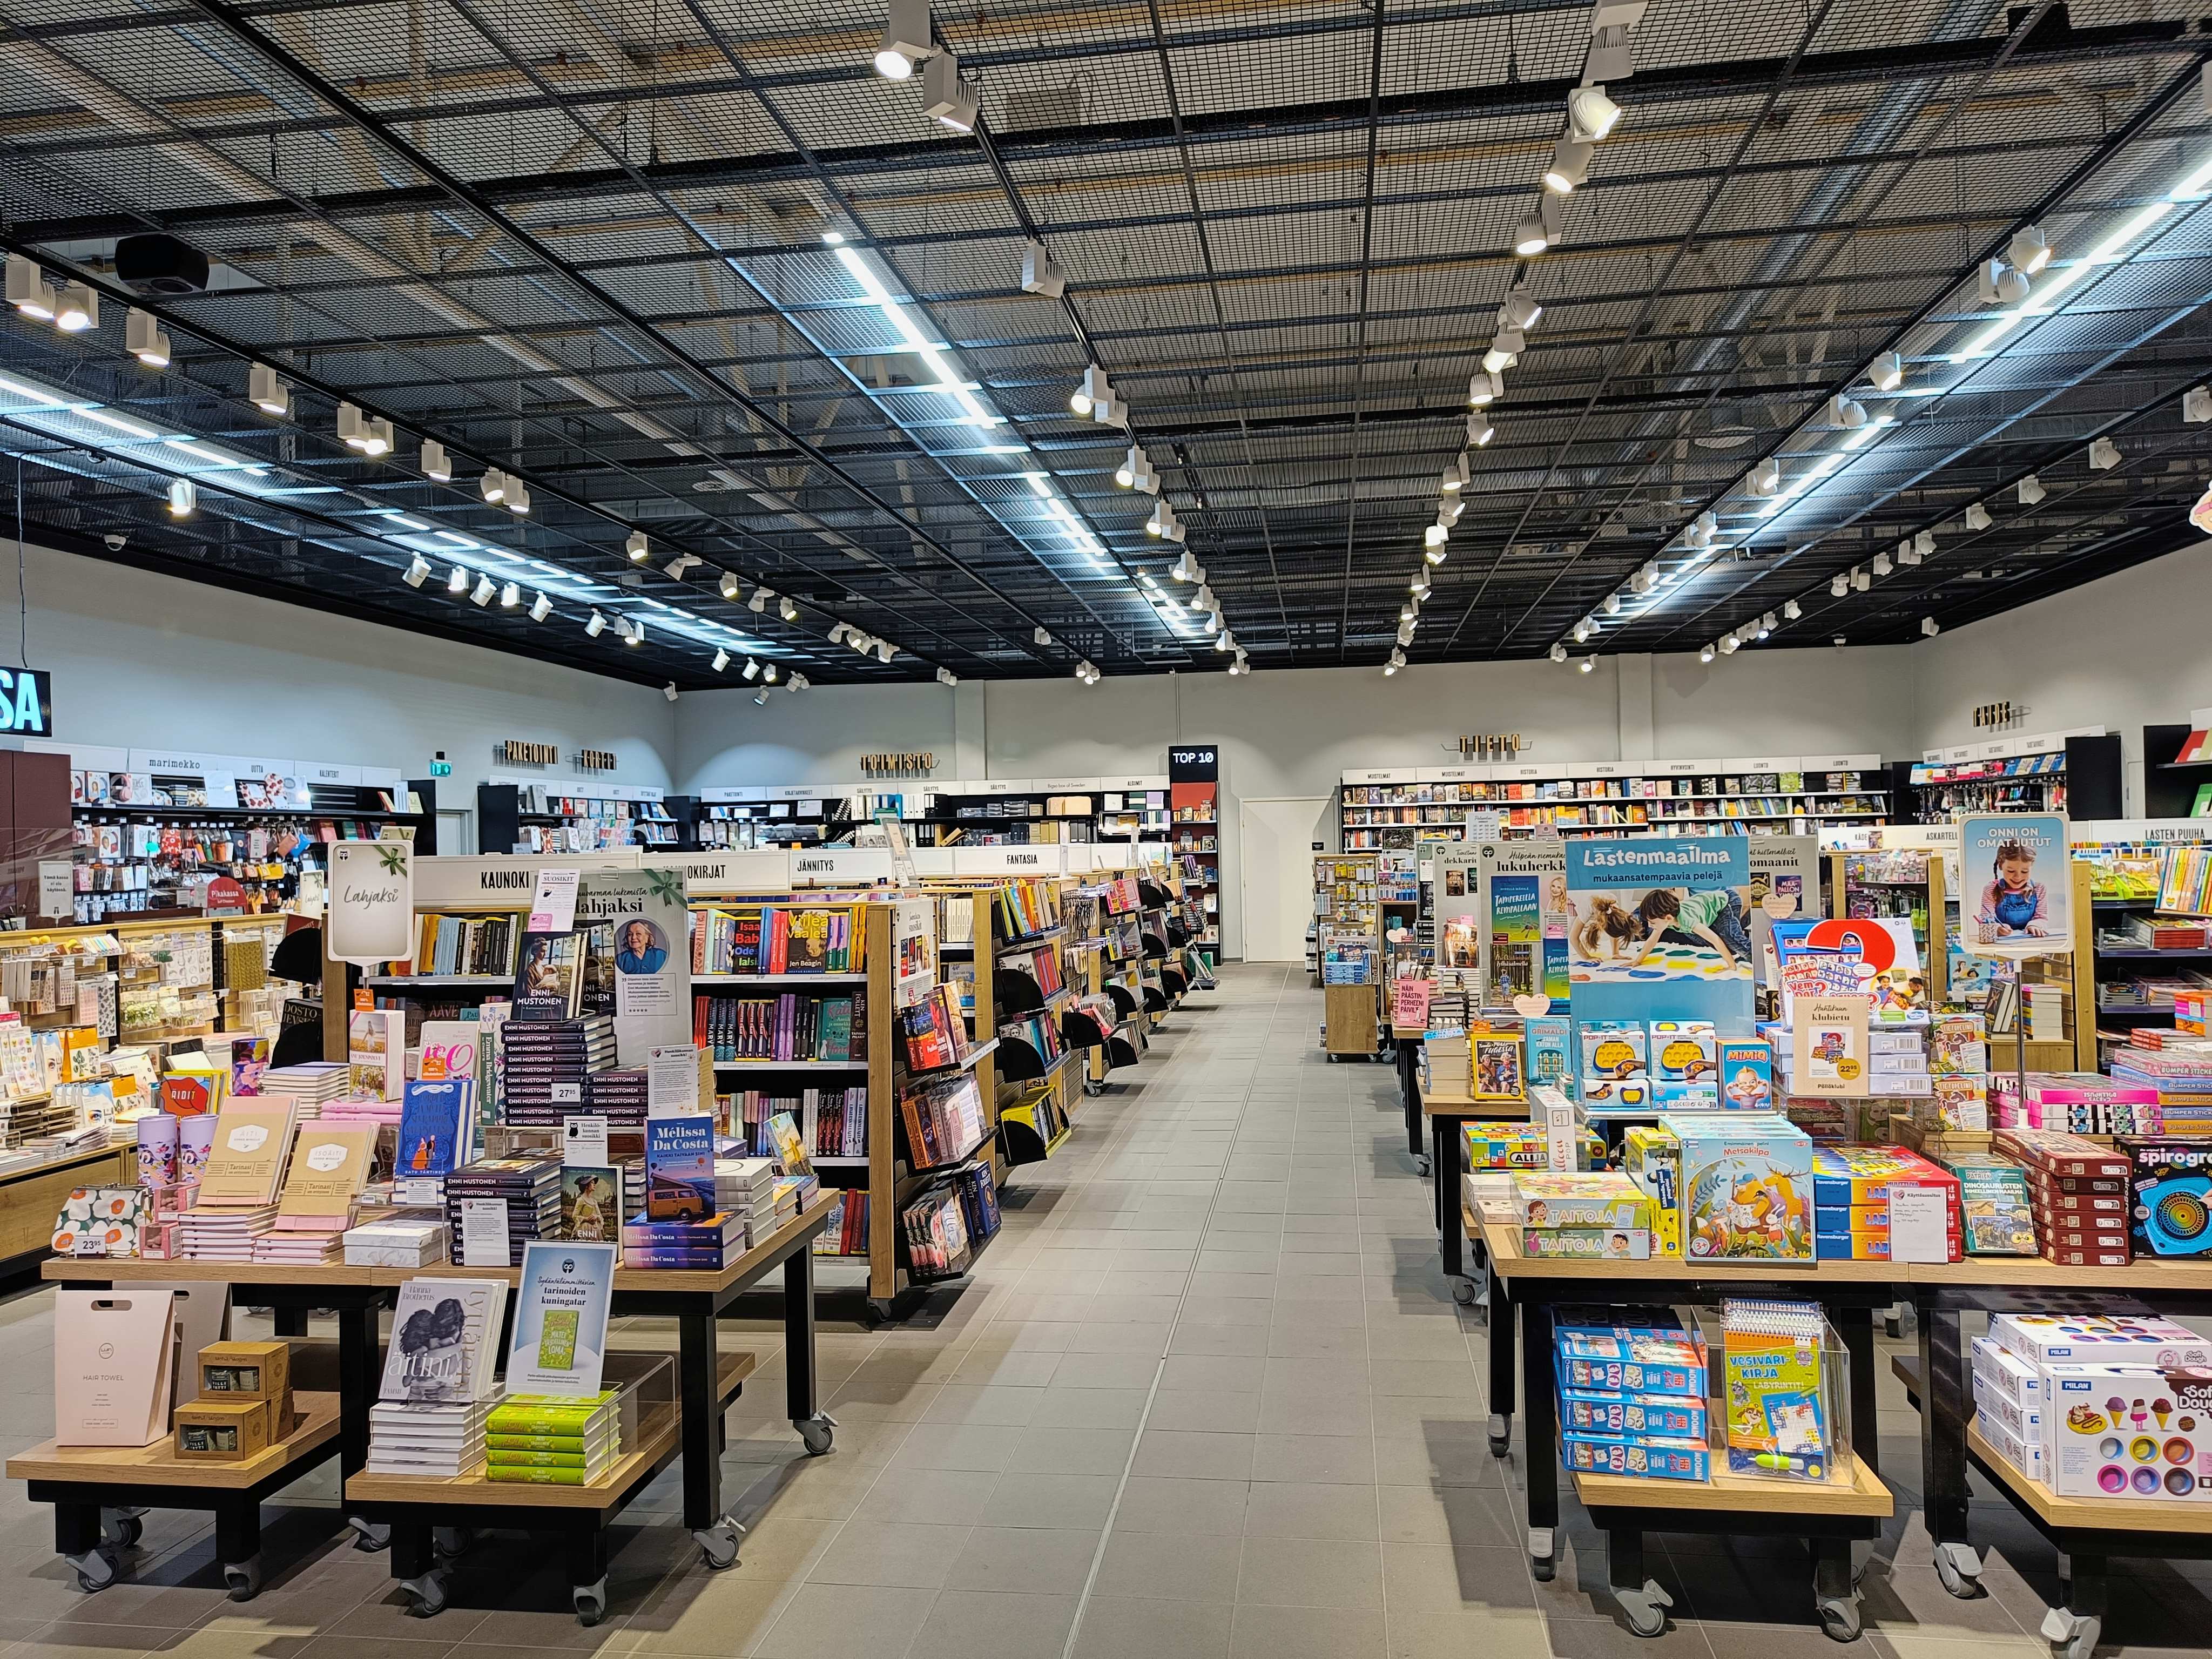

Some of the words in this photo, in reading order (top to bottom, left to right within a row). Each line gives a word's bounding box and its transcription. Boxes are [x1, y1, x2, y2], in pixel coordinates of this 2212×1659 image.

[1973, 702, 2010, 727] TAIDE
[1460, 734, 1520, 752] TIETO
[507, 740, 558, 765] PAKETOINTI
[1172, 752, 1196, 764] TOP
[1198, 752, 1214, 763] 10
[149, 759, 200, 769] marimekko
[861, 752, 933, 771] TOIMISTO
[251, 765, 264, 773] UUTTA
[319, 770, 339, 778] KALENTERIT
[1988, 827, 2018, 838] ONNI
[2021, 827, 2039, 837] ON
[2146, 830, 2175, 840] LASTEN
[2178, 828, 2205, 840] PUUHA
[1174, 841, 1180, 852] 3
[1193, 841, 1200, 851] 4
[1977, 838, 2012, 848] OMAT
[2015, 837, 2051, 848] JUTUT
[1007, 854, 1038, 865] FANTASIA
[1508, 851, 1537, 860] Hilpeän
[1583, 846, 1730, 867] Lastenmaailma
[797, 859, 834, 872] JÄNNITYS
[1593, 871, 1690, 883] mukaansatempaavia
[1693, 871, 1723, 882] pelejä
[211, 889, 239, 899] Pikakassa
[344, 885, 399, 909] Lahjaksi
[612, 887, 648, 896] lukemista
[787, 929, 828, 939] vaalea
[517, 997, 562, 1005] MUSTONEN
[1813, 1003, 1848, 1013] Huhtikuun
[1812, 1013, 1850, 1021] klubietu
[2162, 1067, 2188, 1075] BUMPER
[656, 1125, 706, 1138] Mélissa
[653, 1140, 671, 1151] Da
[672, 1137, 709, 1150] Costa
[1723, 1148, 1770, 1157] Metsäkilpa
[1551, 1210, 1616, 1224] TAITOJA
[1539, 1238, 1606, 1252] TAITOJA
[1695, 1241, 1708, 1251] 3+
[403, 1292, 435, 1301] Brotherus
[544, 1287, 586, 1296] tarinoiden
[541, 1297, 587, 1307] kuningatar
[1741, 1368, 1779, 1379] KIRJA
[1688, 1368, 1696, 1396] MOOMIN
[1753, 1381, 1805, 1391] LABYRINTIT!
[1691, 1410, 1700, 1438] MOOMIN
[1695, 1451, 1703, 1480] MOOMIN
